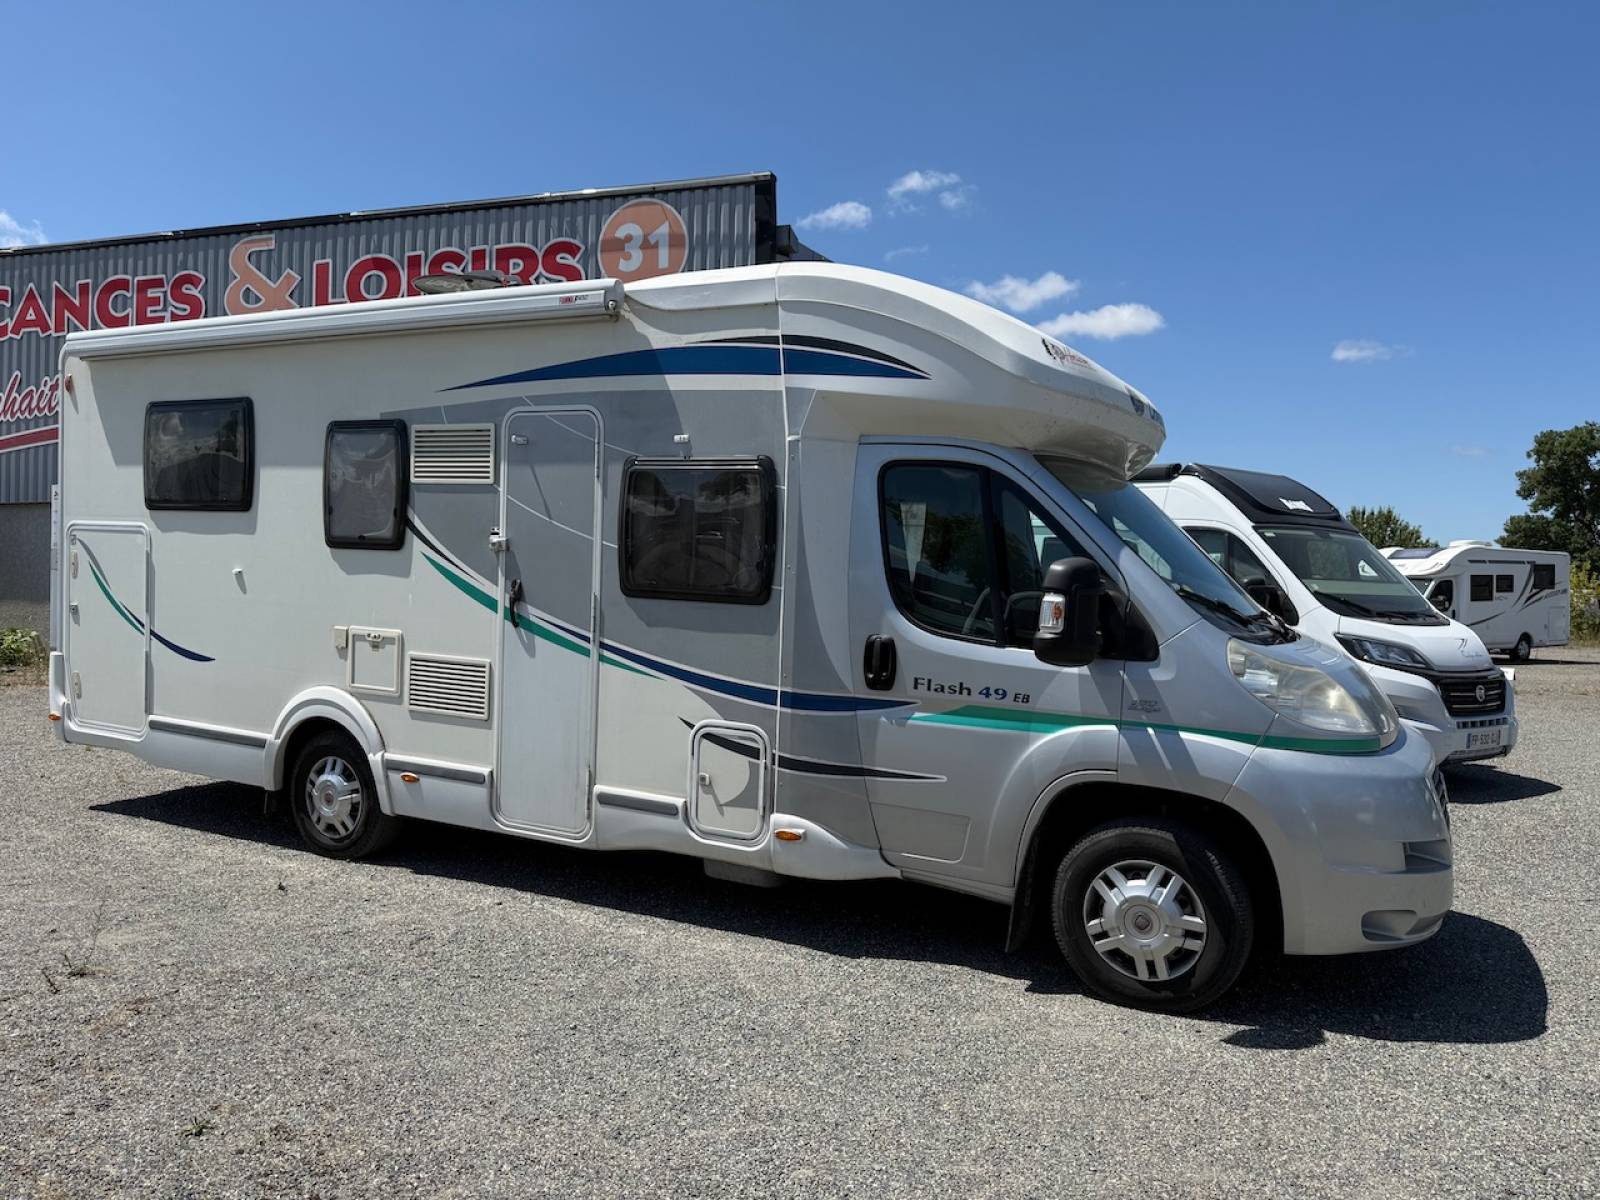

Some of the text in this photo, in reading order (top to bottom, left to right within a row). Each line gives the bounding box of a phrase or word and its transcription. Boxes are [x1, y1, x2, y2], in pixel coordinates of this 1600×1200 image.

[224, 234, 301, 316] &
[313, 237, 586, 307] LOISIRS
[614, 220, 670, 273] 31
[0, 370, 60, 422] hait
[912, 676, 1031, 704] Flash 49 EB
